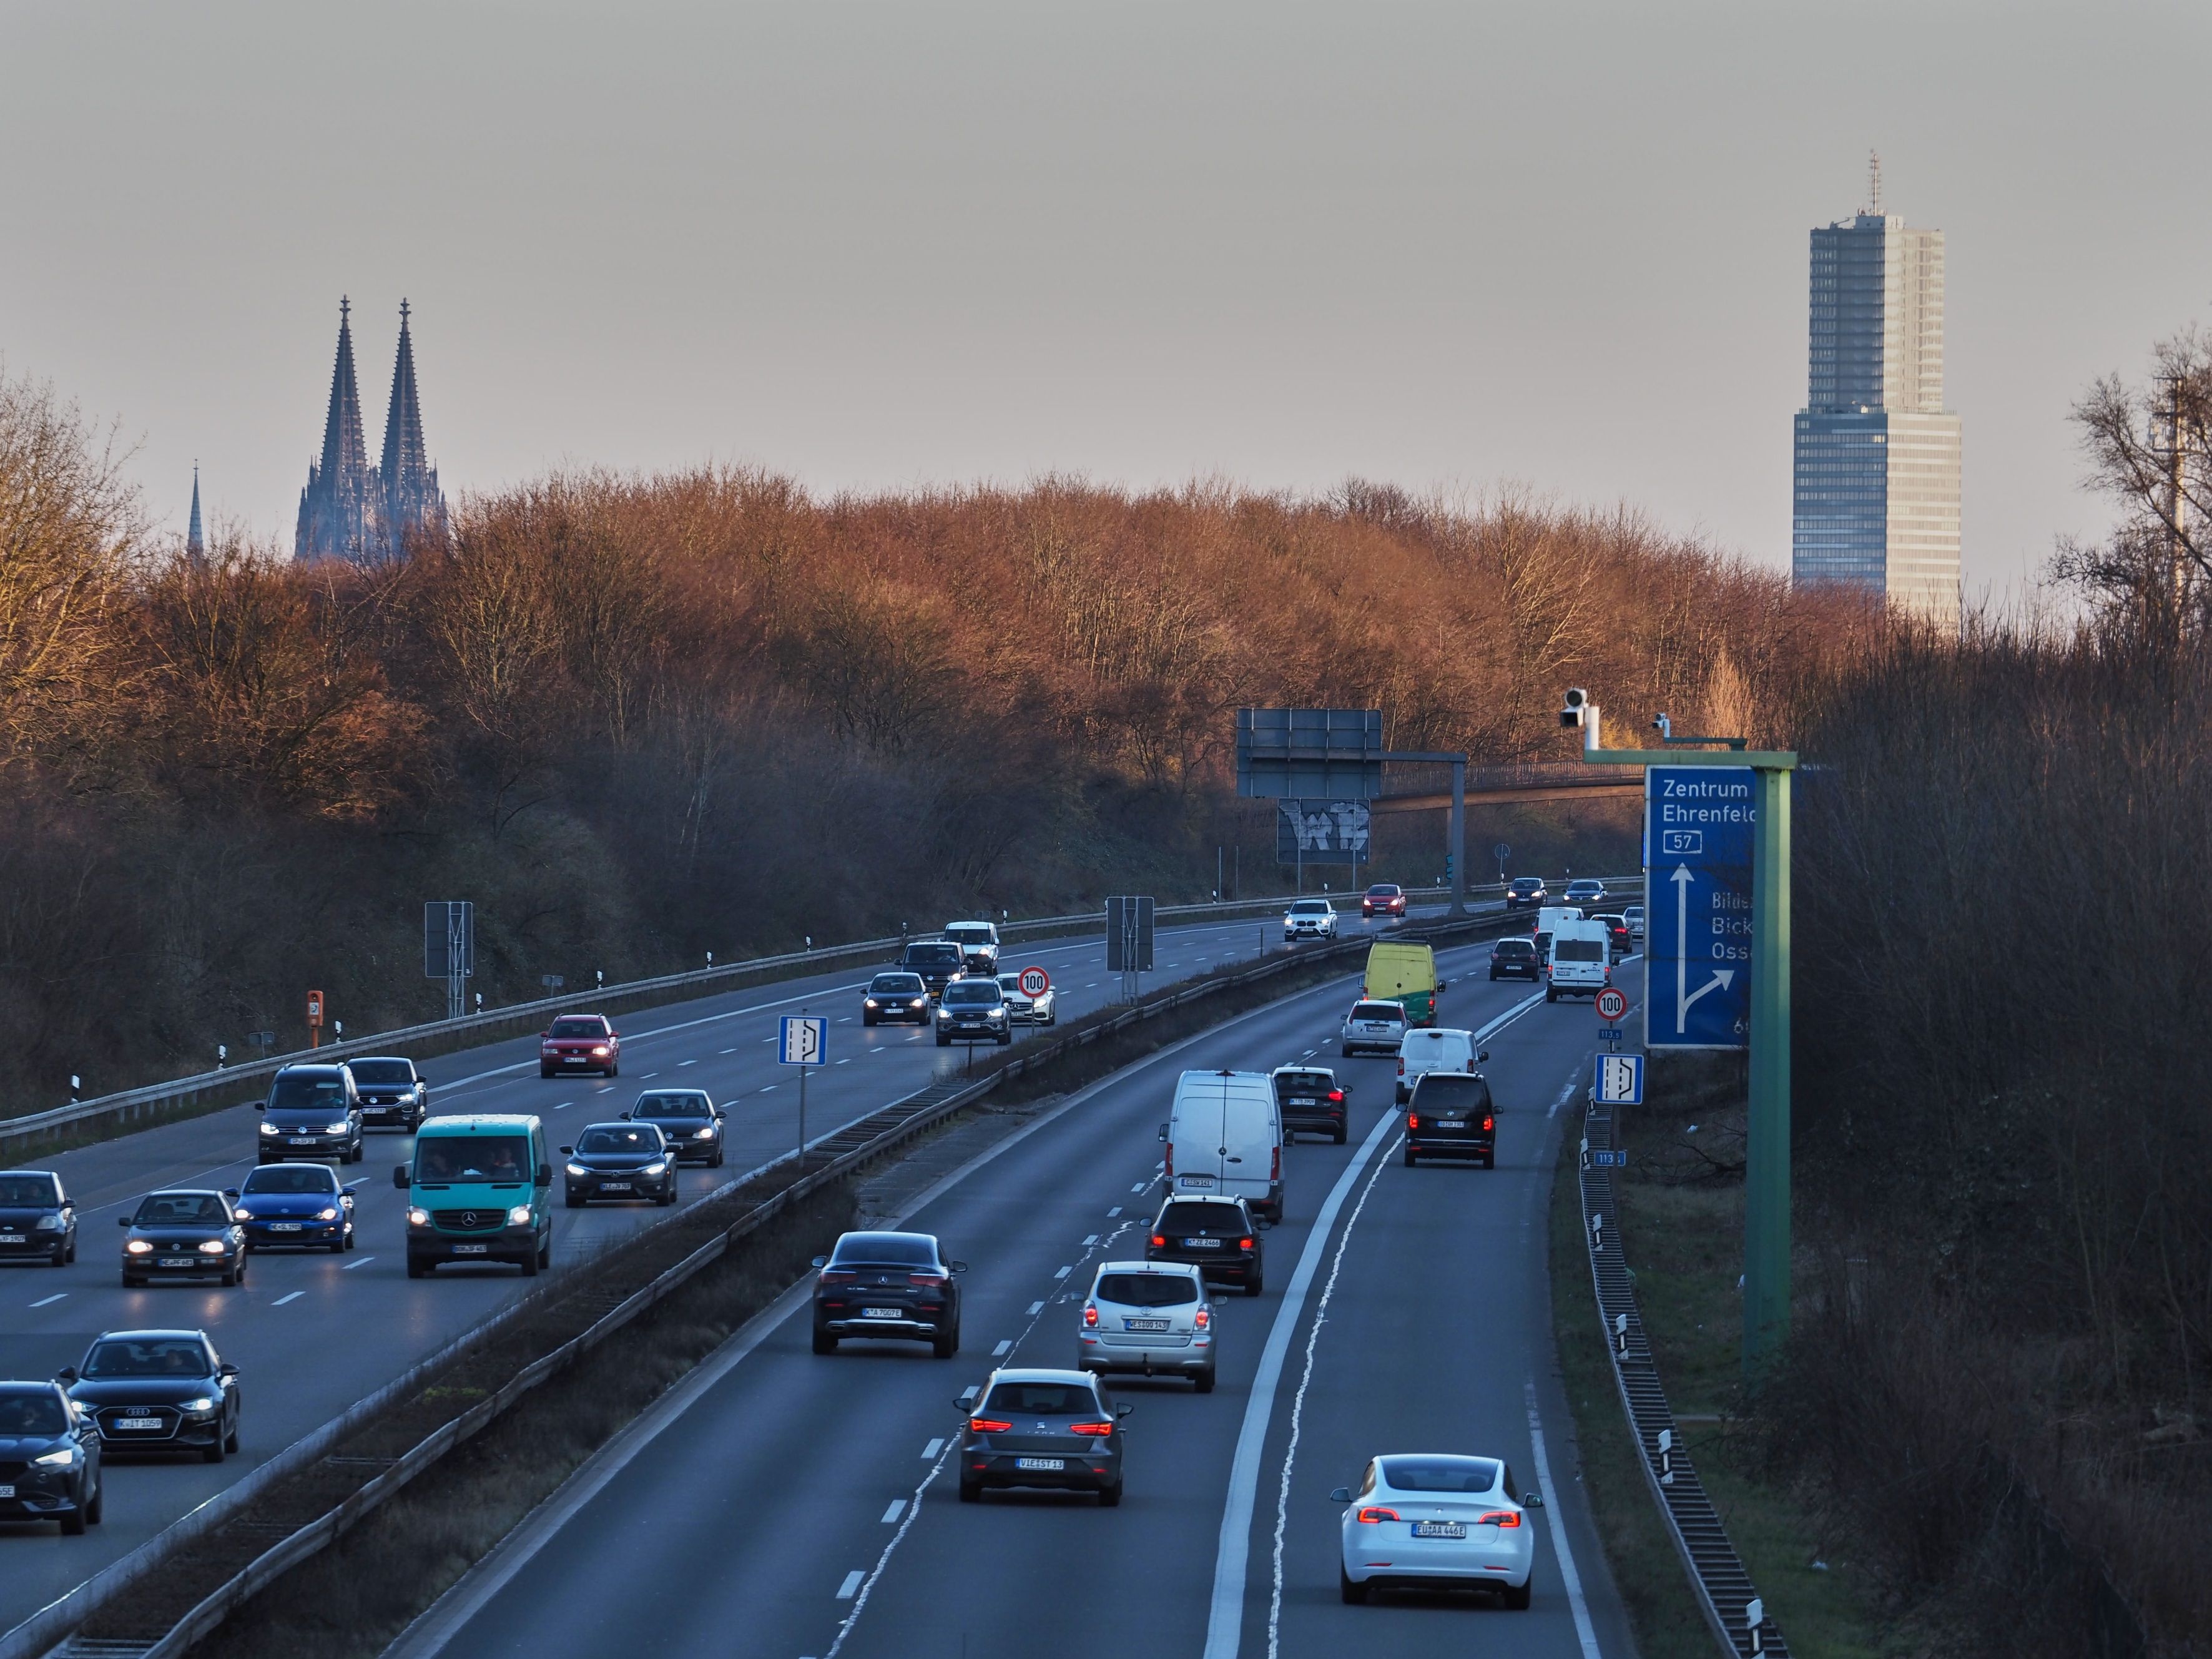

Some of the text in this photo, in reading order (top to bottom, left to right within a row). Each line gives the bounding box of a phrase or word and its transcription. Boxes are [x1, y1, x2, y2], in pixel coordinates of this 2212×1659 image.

[1663, 779, 1748, 797] Zentrum
[1674, 835, 1692, 849] 57
[1713, 892, 1753, 908] Bilde
[1712, 942, 1752, 960] Oss
[1025, 975, 1043, 990] 100
[1601, 997, 1620, 1012] 100
[1021, 1459, 1063, 1469] VIE ST 13
[1417, 1525, 1427, 1534] EU
[1432, 1525, 1442, 1534] AA
